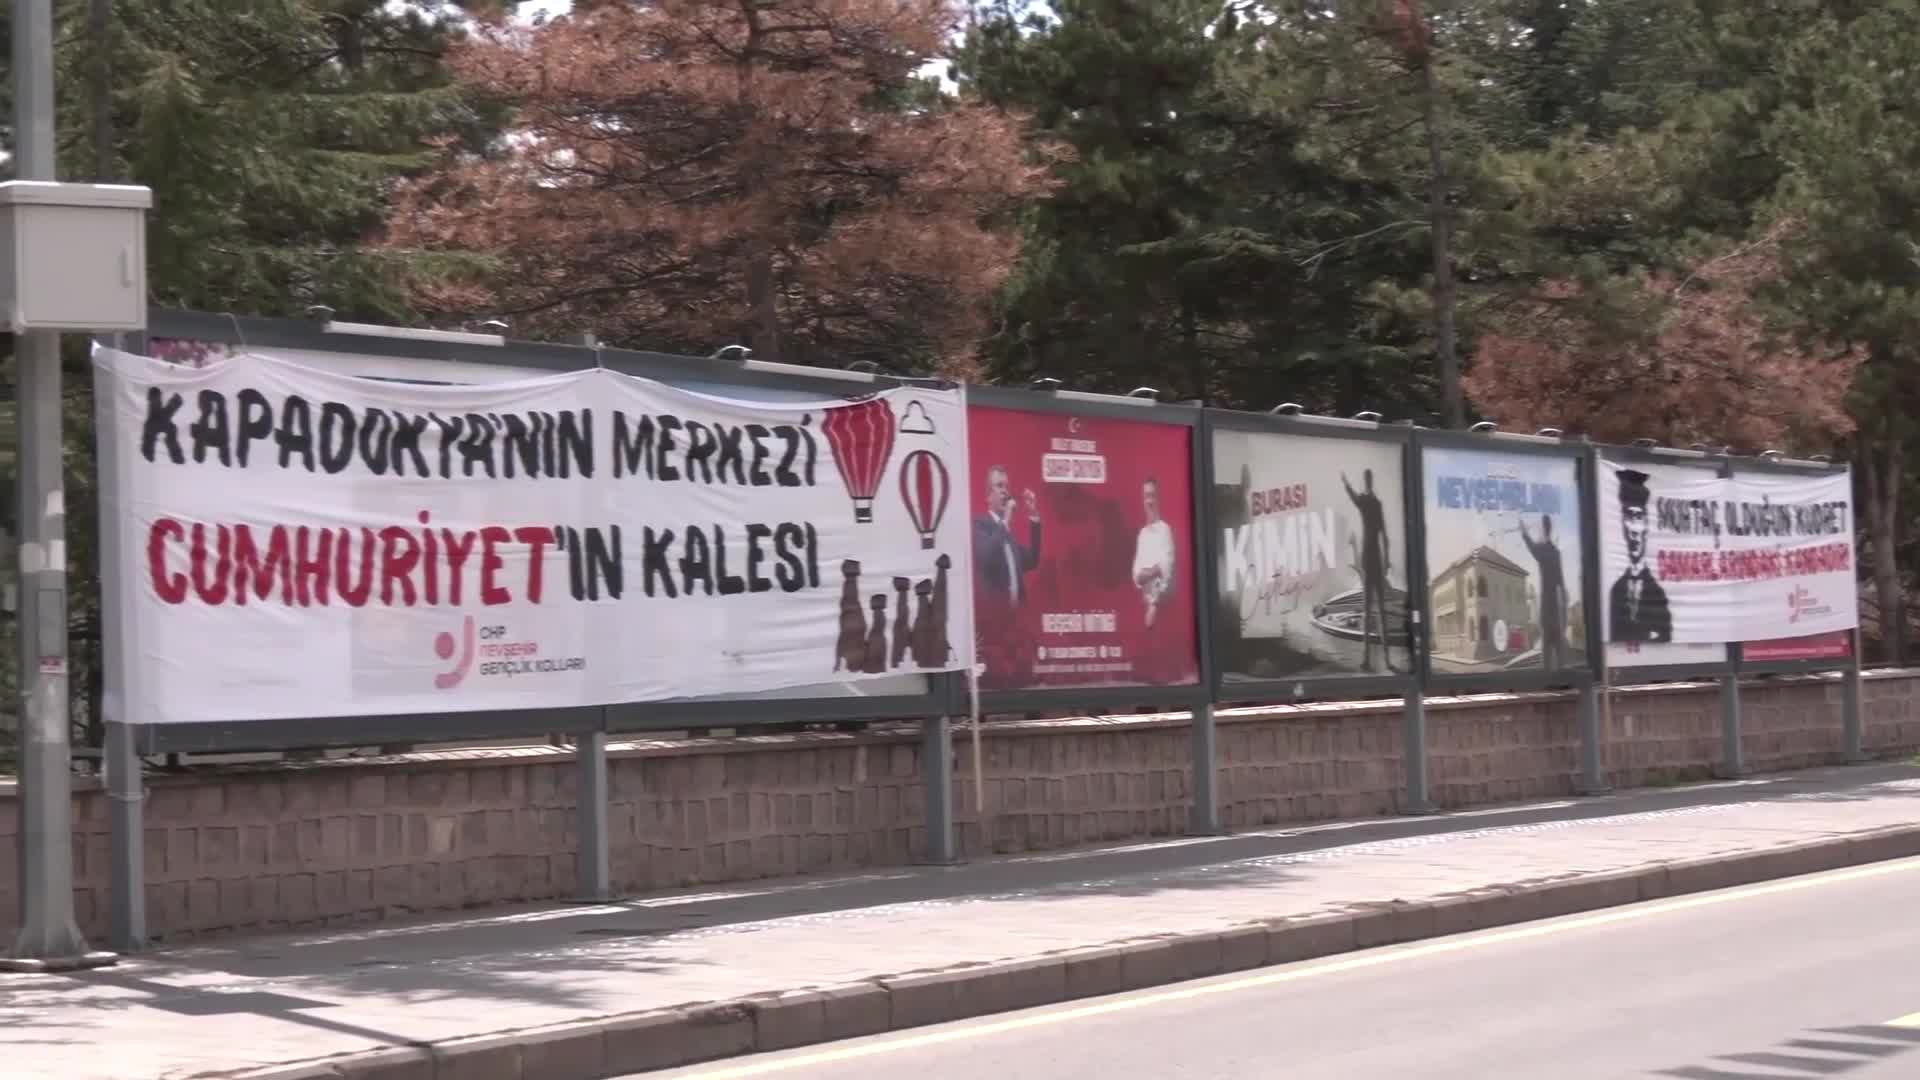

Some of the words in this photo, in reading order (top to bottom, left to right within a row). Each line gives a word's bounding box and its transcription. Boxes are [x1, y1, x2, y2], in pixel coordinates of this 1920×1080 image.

[141, 386, 594, 479] KAPADOKYA'NIN
[612, 413, 816, 487] MERKEZİ
[1251, 482, 1307, 517] BURASI
[480, 626, 506, 639] CHP
